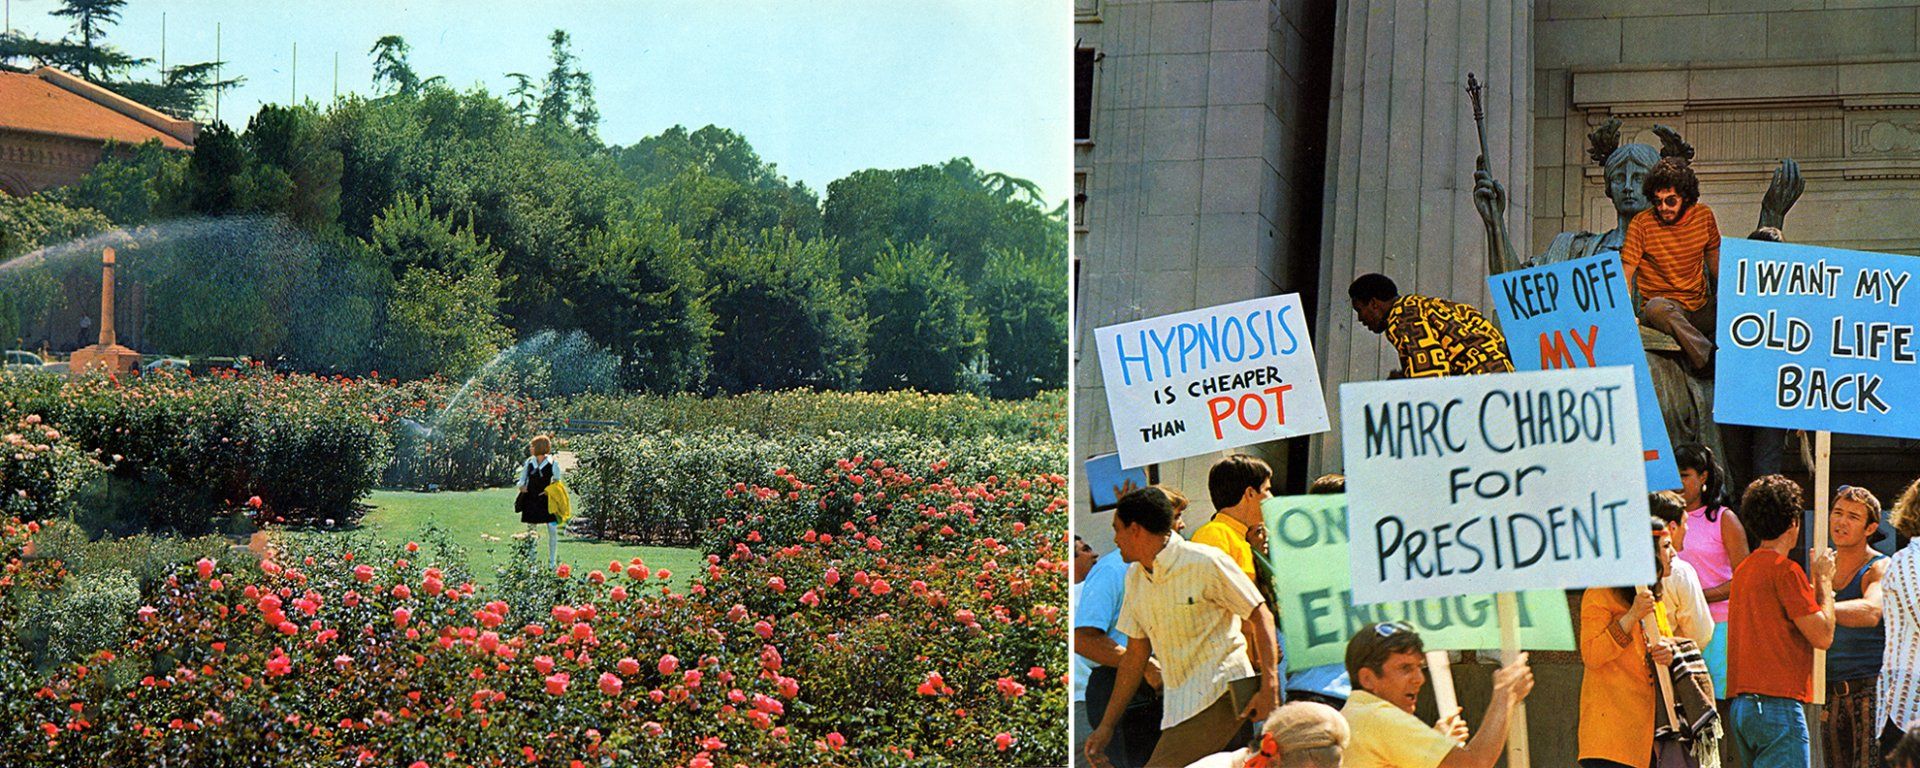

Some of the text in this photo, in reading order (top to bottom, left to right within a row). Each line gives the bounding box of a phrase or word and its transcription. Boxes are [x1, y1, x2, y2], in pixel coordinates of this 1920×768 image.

[1503, 258, 1616, 320] KEEP OFF
[1736, 258, 1911, 307] I WANT MY
[1116, 305, 1298, 385] HYPNOSIS
[1539, 325, 1598, 370] MY
[1730, 309, 1917, 364] OLD LIFE
[1140, 384, 1293, 442] THAN POT
[1154, 366, 1282, 404] IS CHEAPER
[1776, 363, 1891, 415] BACK
[1363, 385, 1621, 459] MARC CHABOT
[1375, 492, 1628, 582] PRESIDENT
